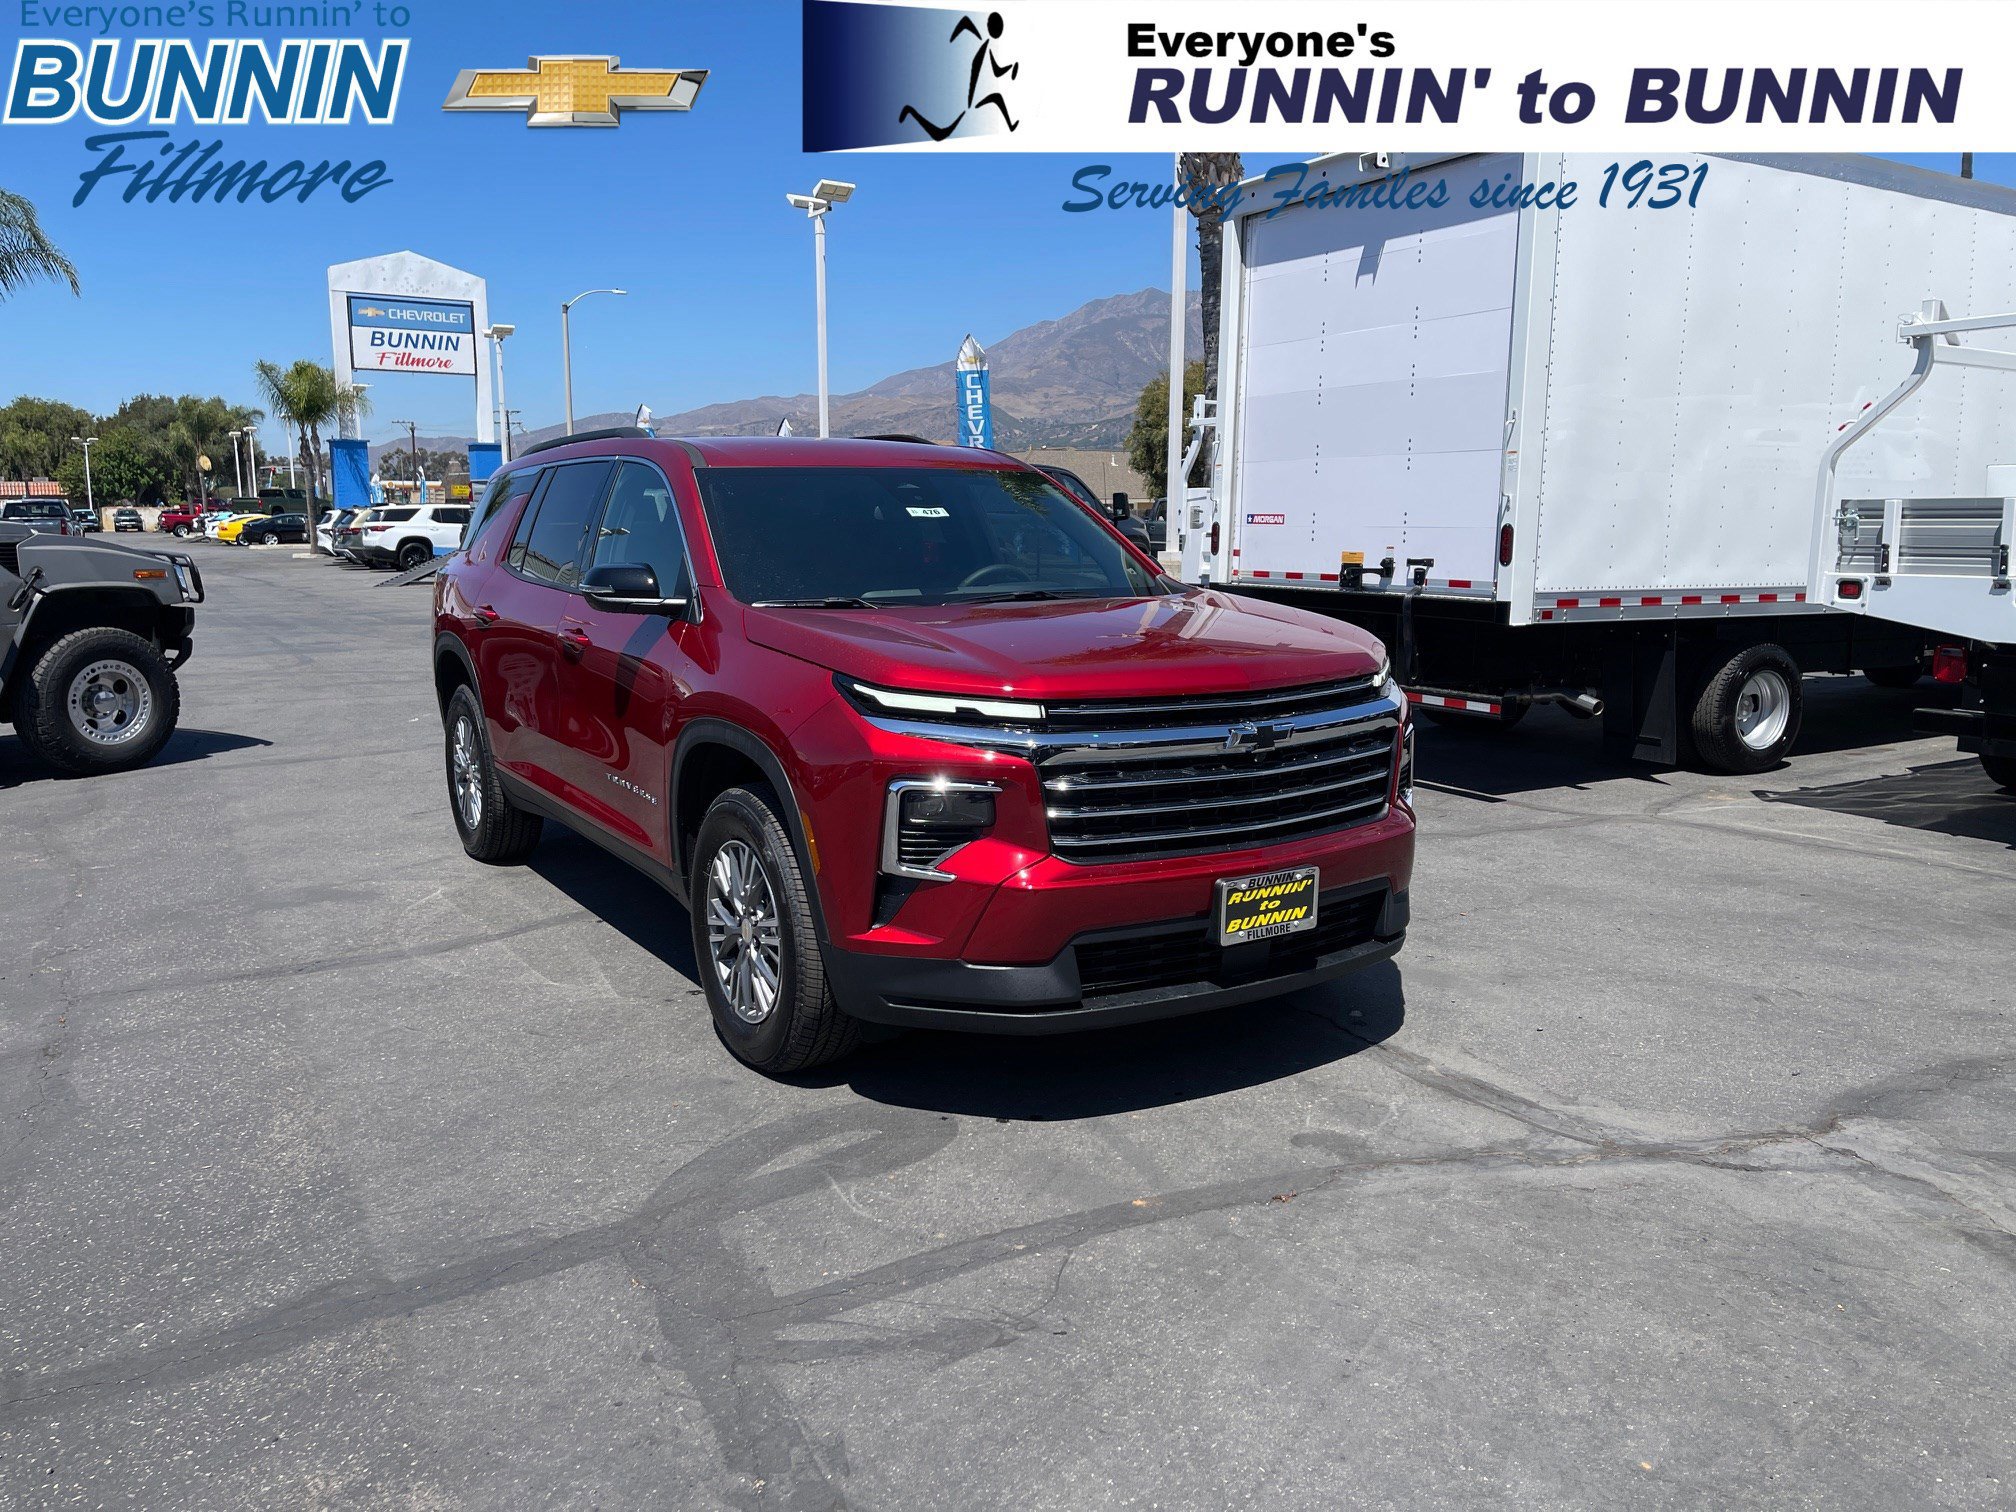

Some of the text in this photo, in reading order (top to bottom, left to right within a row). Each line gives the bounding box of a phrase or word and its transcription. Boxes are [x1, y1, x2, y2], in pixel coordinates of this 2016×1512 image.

[388, 308, 466, 324] CHEVROLET
[370, 330, 461, 352] BUNNIN
[375, 351, 454, 369] Fillmore
[1253, 515, 1284, 524] MORGAN
[1248, 872, 1295, 887] BUNNIN
[1227, 879, 1313, 906] RUNNIN'
[1259, 900, 1281, 911] to
[1226, 906, 1308, 933] BUNNIN
[1247, 923, 1291, 940] FILLMORE
